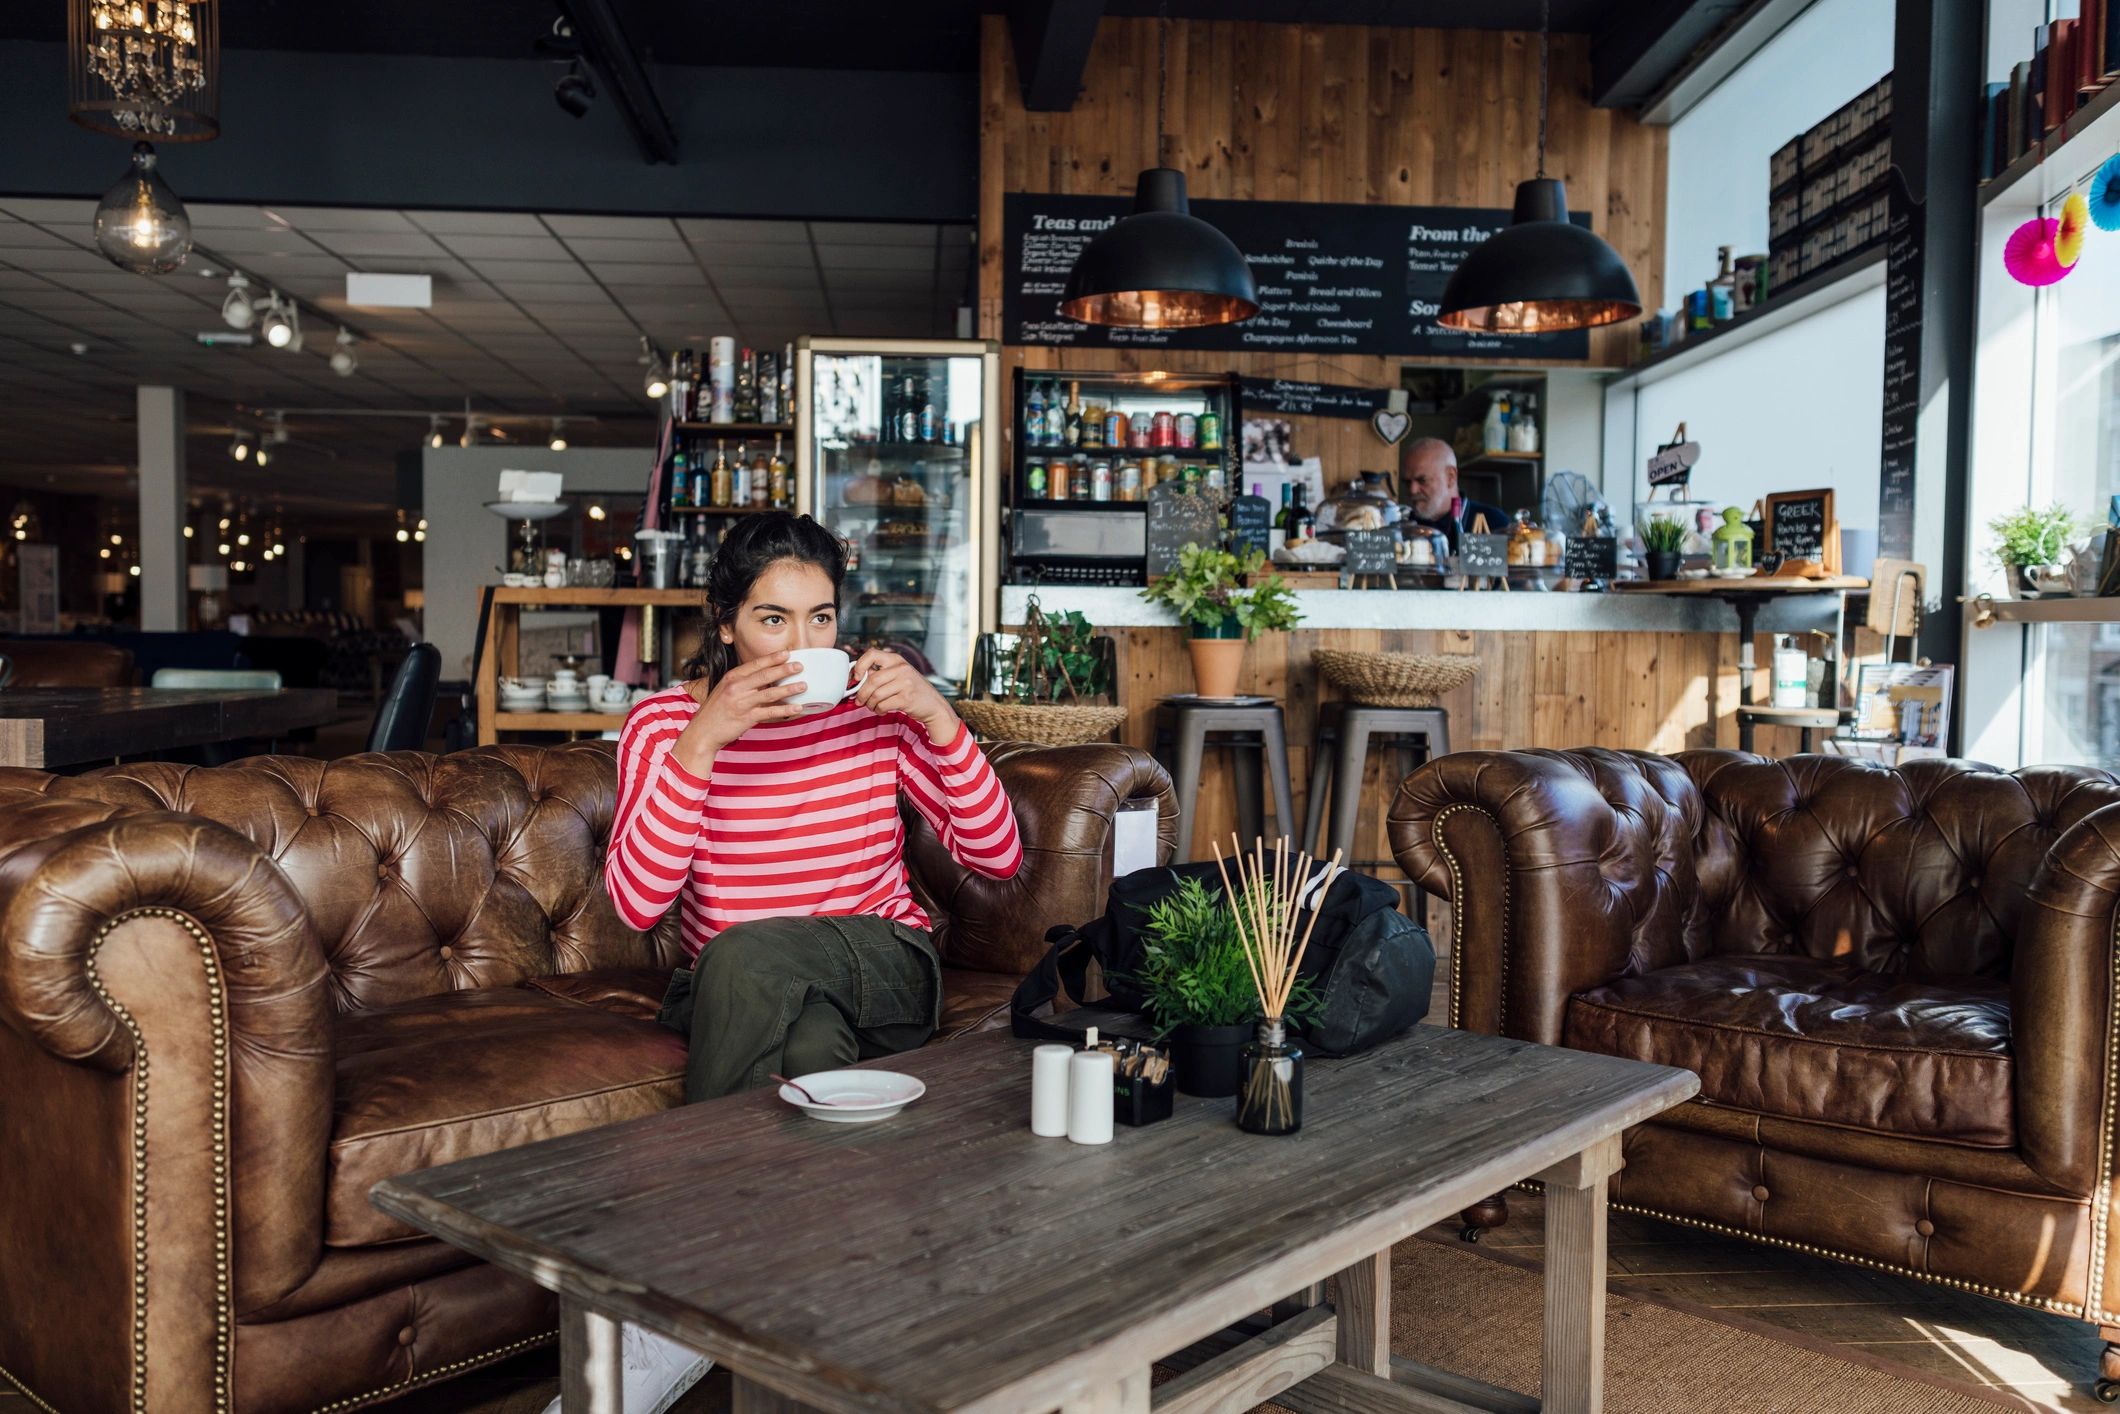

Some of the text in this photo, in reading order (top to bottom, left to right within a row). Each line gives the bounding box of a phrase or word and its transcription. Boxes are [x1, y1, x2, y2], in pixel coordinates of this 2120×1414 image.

[1033, 215, 1116, 230] Teas and
[1409, 225, 1491, 242] From the
[1244, 254, 1383, 269] Sandwiches Quiche of the Day
[1258, 285, 1382, 298] Platters Bread and Olives
[1262, 302, 1341, 313] Super Food Salads
[1247, 317, 1258, 327] of
[1257, 317, 1270, 326] the
[1271, 318, 1291, 328] Day
[1317, 318, 1373, 329] Cheeseboard
[1243, 332, 1357, 344] Champagne Afternoon Tea
[1650, 462, 1677, 479] OPEN
[1778, 502, 1821, 522] GREEK
